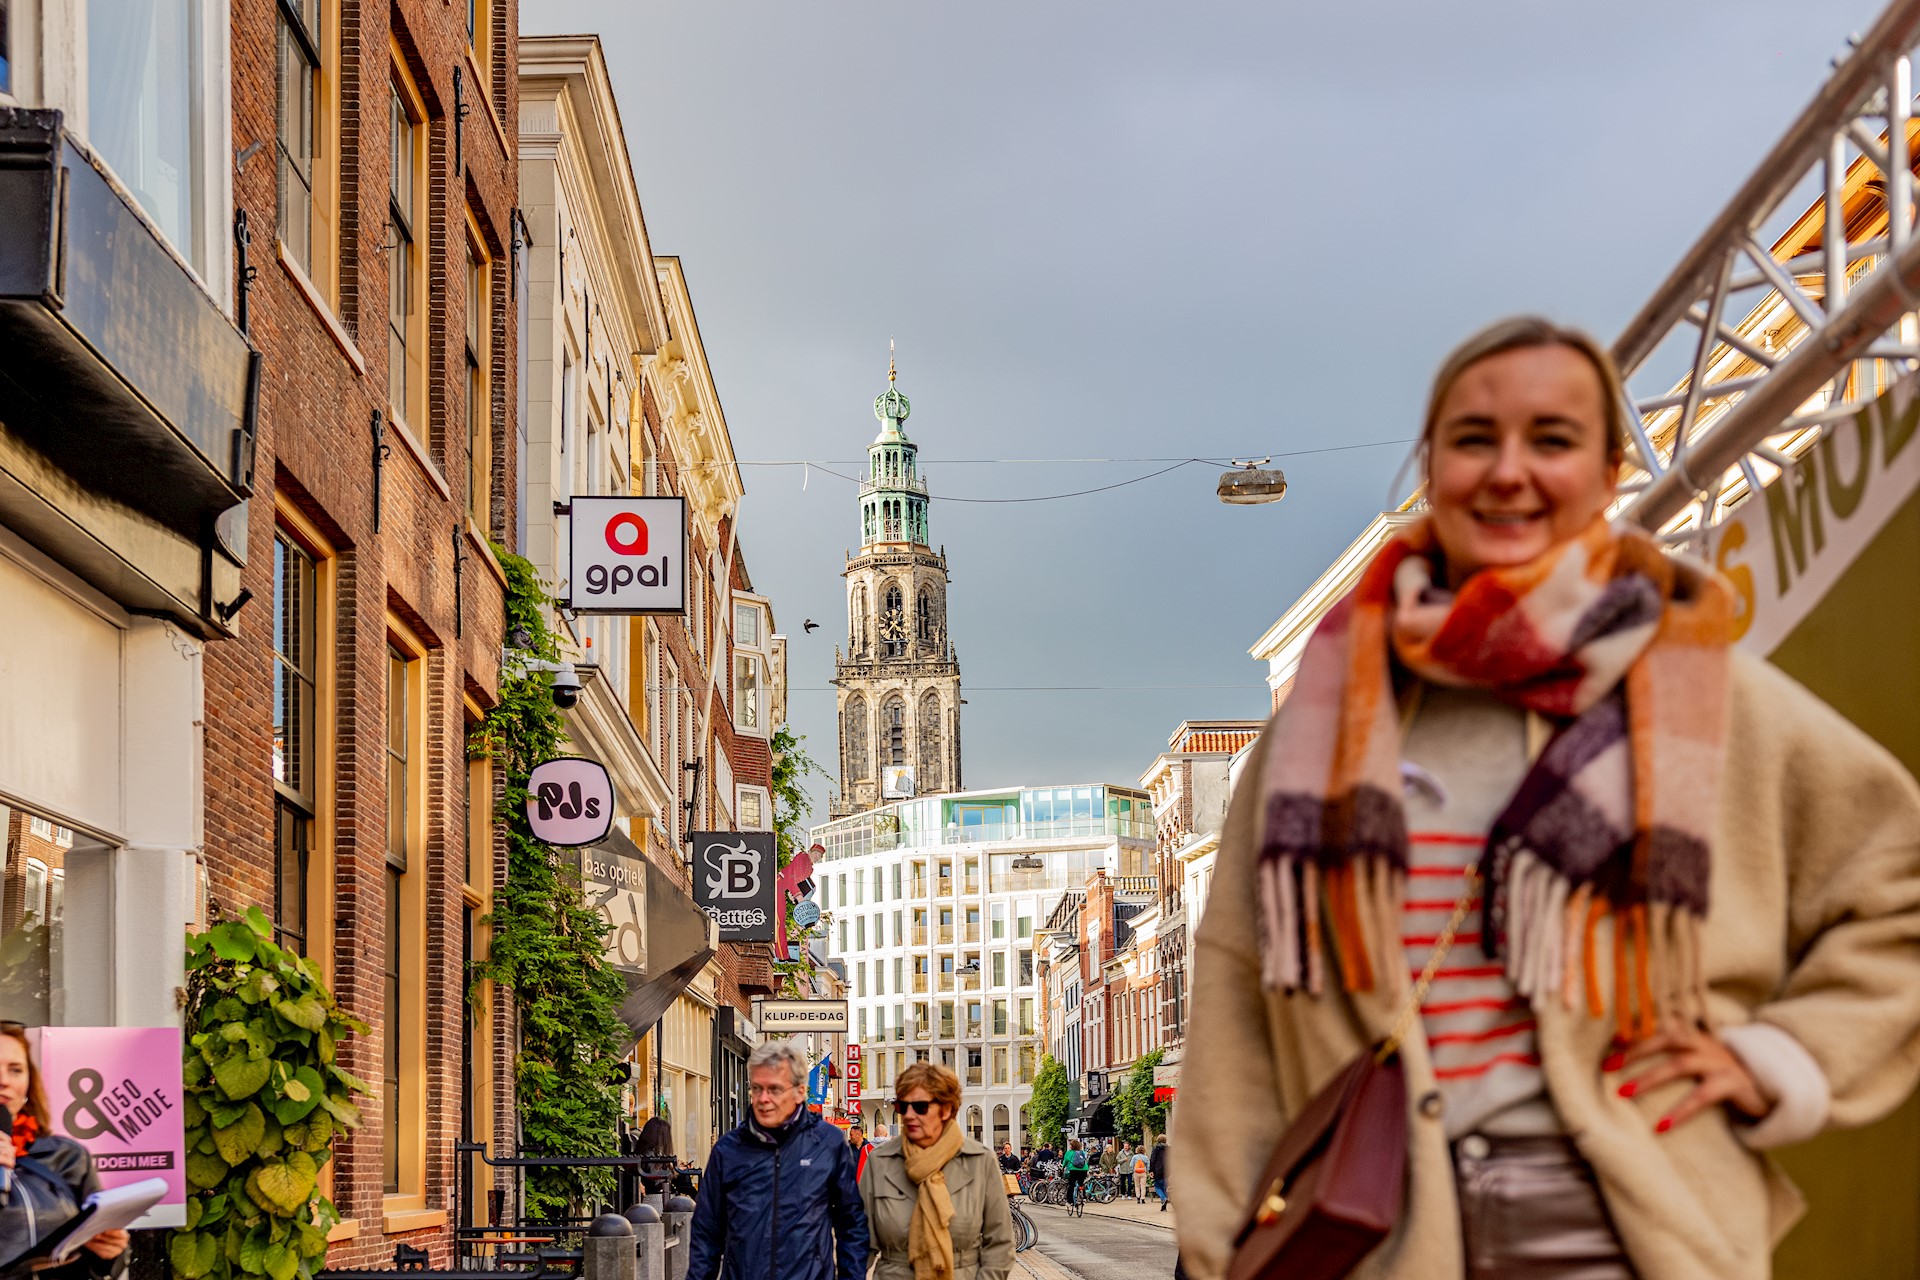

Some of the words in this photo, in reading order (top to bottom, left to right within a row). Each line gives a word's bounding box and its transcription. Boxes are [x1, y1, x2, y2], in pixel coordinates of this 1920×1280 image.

[586, 556, 667, 594] gpal
[538, 781, 600, 820] PJs
[584, 850, 605, 877] bas
[609, 865, 644, 887] optiek
[728, 860, 754, 892] B
[709, 911, 762, 923] Betties
[101, 1079, 142, 1117] 050
[848, 1047, 859, 1113] HOEK
[118, 1088, 173, 1139] MODE
[98, 1157, 136, 1169] DOEN
[138, 1154, 168, 1167] MEE
